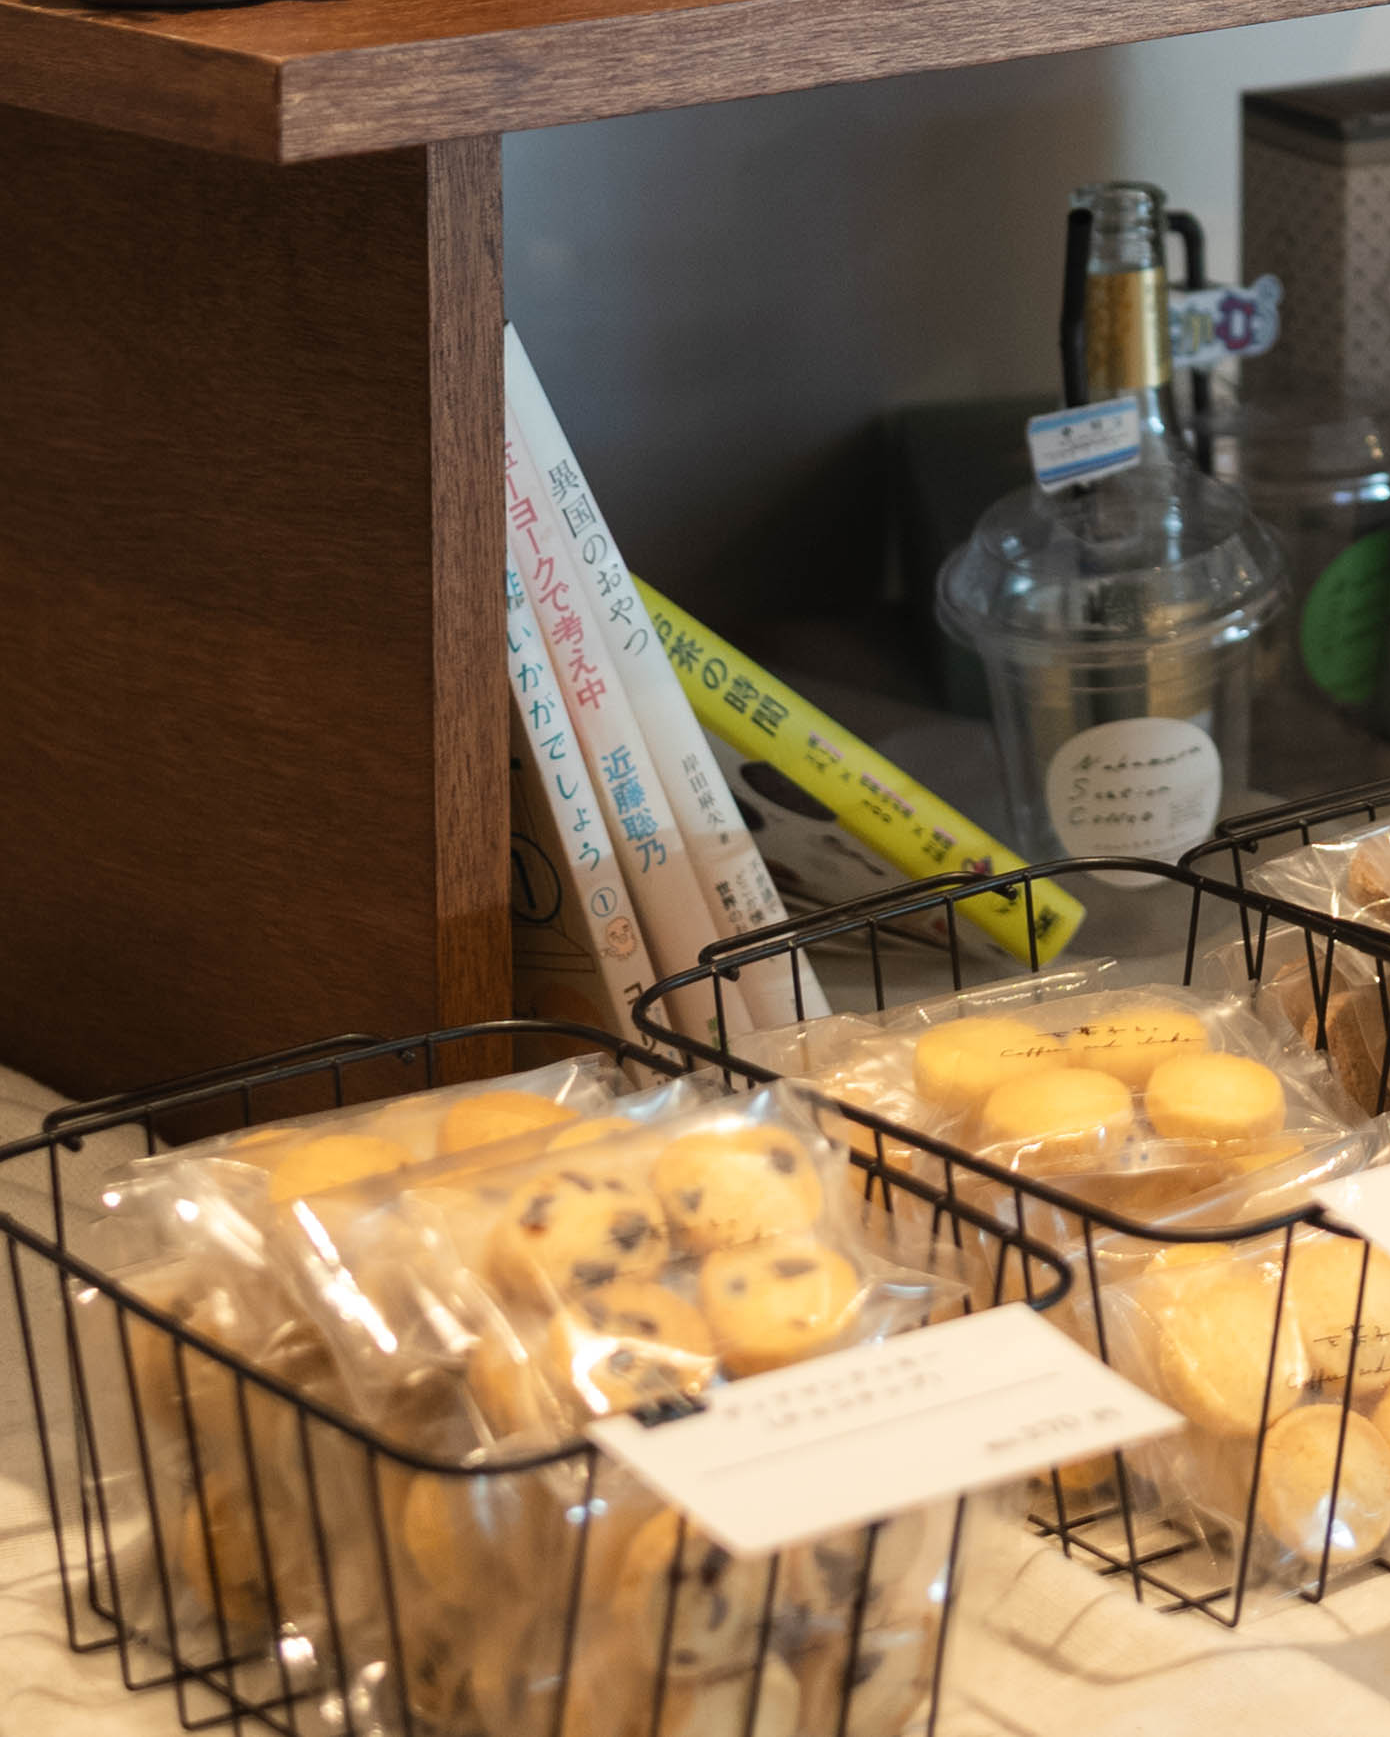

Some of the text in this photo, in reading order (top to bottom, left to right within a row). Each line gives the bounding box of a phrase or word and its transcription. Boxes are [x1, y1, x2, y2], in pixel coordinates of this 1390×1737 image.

[548, 459, 650, 656] 異国のおやつ
[654, 613, 790, 738] お茶の時間
[601, 744, 667, 874] 近藤聡乃
